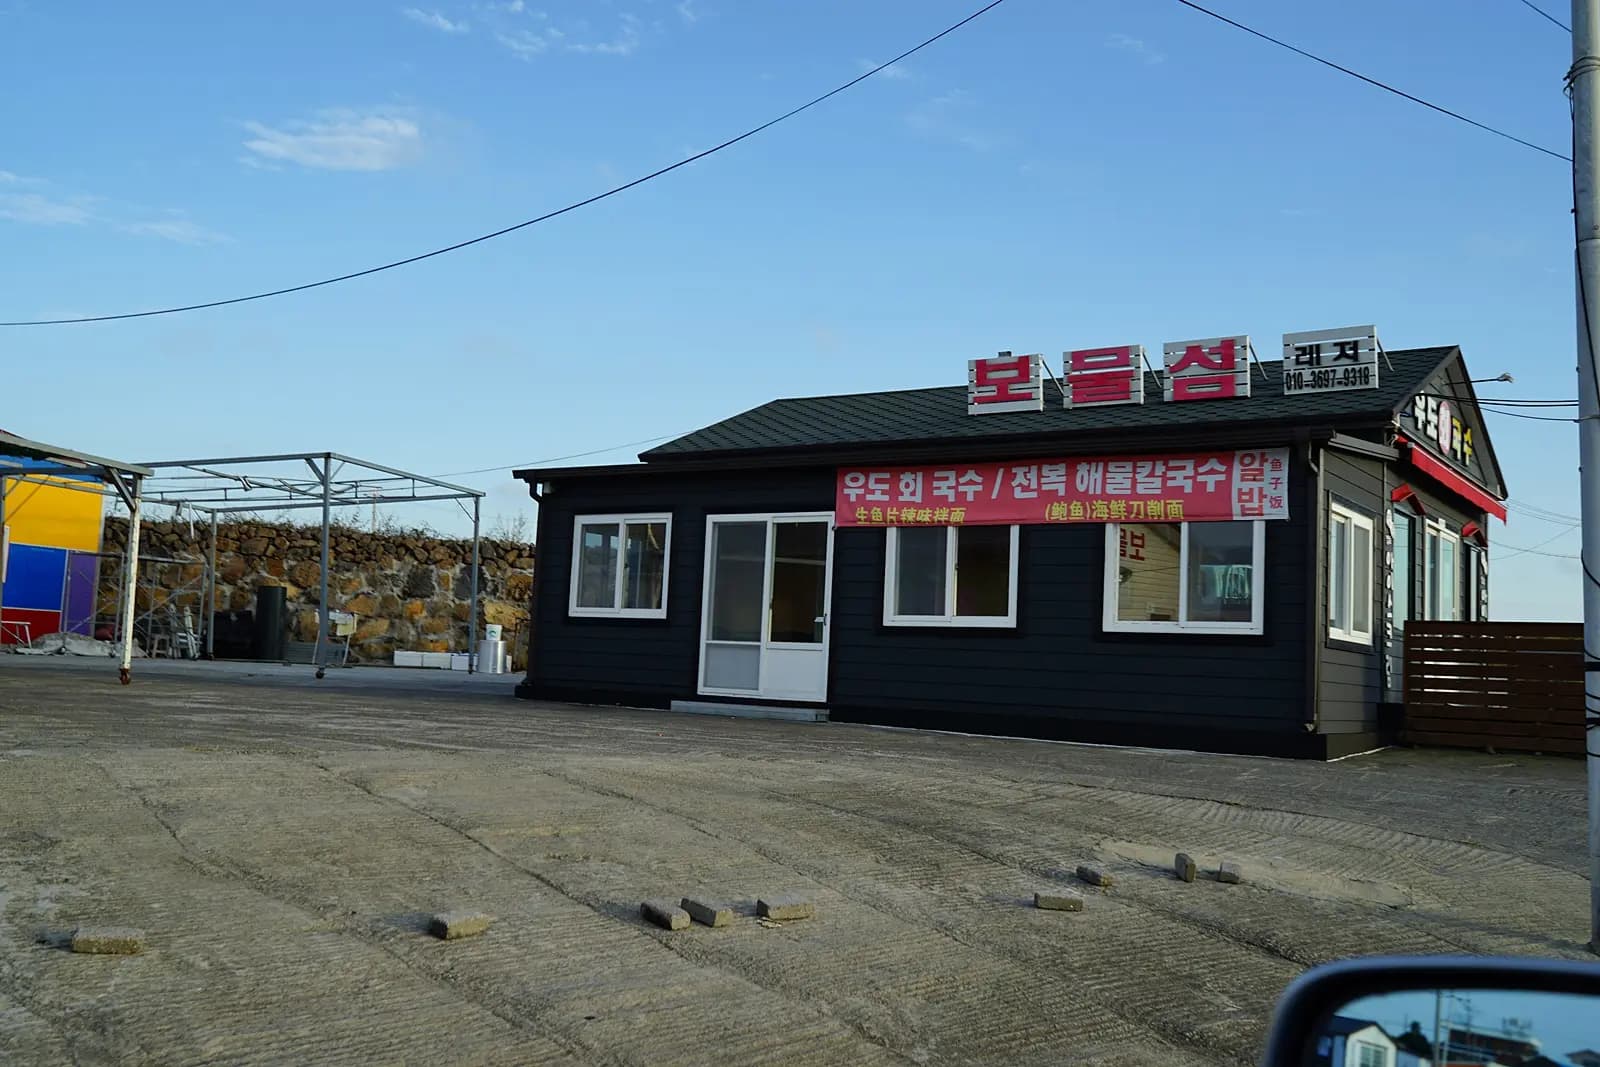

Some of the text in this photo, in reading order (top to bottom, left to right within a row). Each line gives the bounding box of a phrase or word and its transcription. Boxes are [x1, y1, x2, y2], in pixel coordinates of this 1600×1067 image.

[973, 339, 1236, 404] 보물섬
[1286, 366, 1369, 390] 010-3697-9318
[843, 472, 890, 502] 우도
[898, 471, 923, 502] 회
[932, 470, 984, 502] 국수
[1011, 463, 1067, 499] 전복
[1075, 457, 1227, 495] 해물칼국수
[1238, 452, 1268, 517] 알밥
[1268, 458, 1283, 509] 鱼子饭
